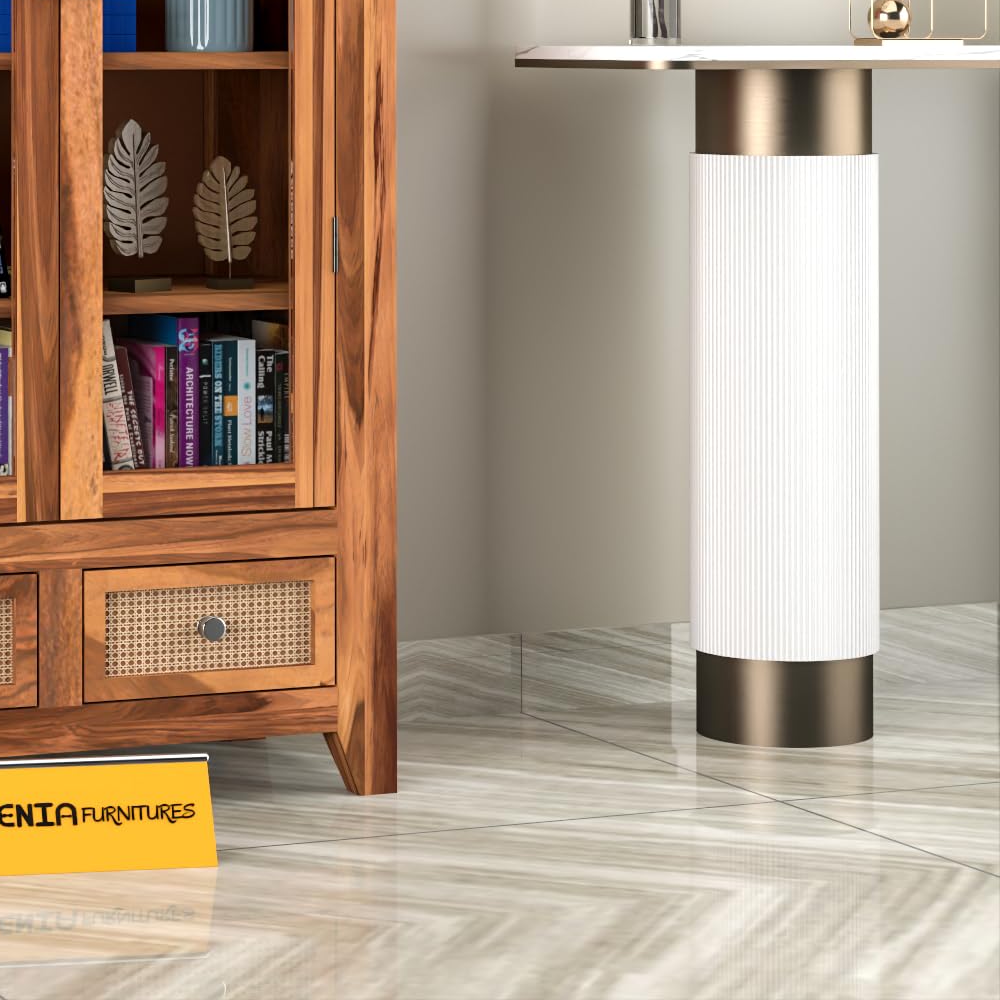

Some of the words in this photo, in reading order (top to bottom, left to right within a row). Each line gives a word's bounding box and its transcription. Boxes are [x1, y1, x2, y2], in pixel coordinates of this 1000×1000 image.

[214, 344, 223, 379] RIDERS
[257, 355, 265, 389] Calling
[266, 355, 274, 372] The
[103, 363, 118, 395] ORWELL
[214, 380, 223, 394] ON
[185, 367, 194, 440] ARCHITECTURE
[214, 395, 223, 413] THE
[214, 415, 223, 447] STORM
[81, 803, 196, 826] FURNITURES
